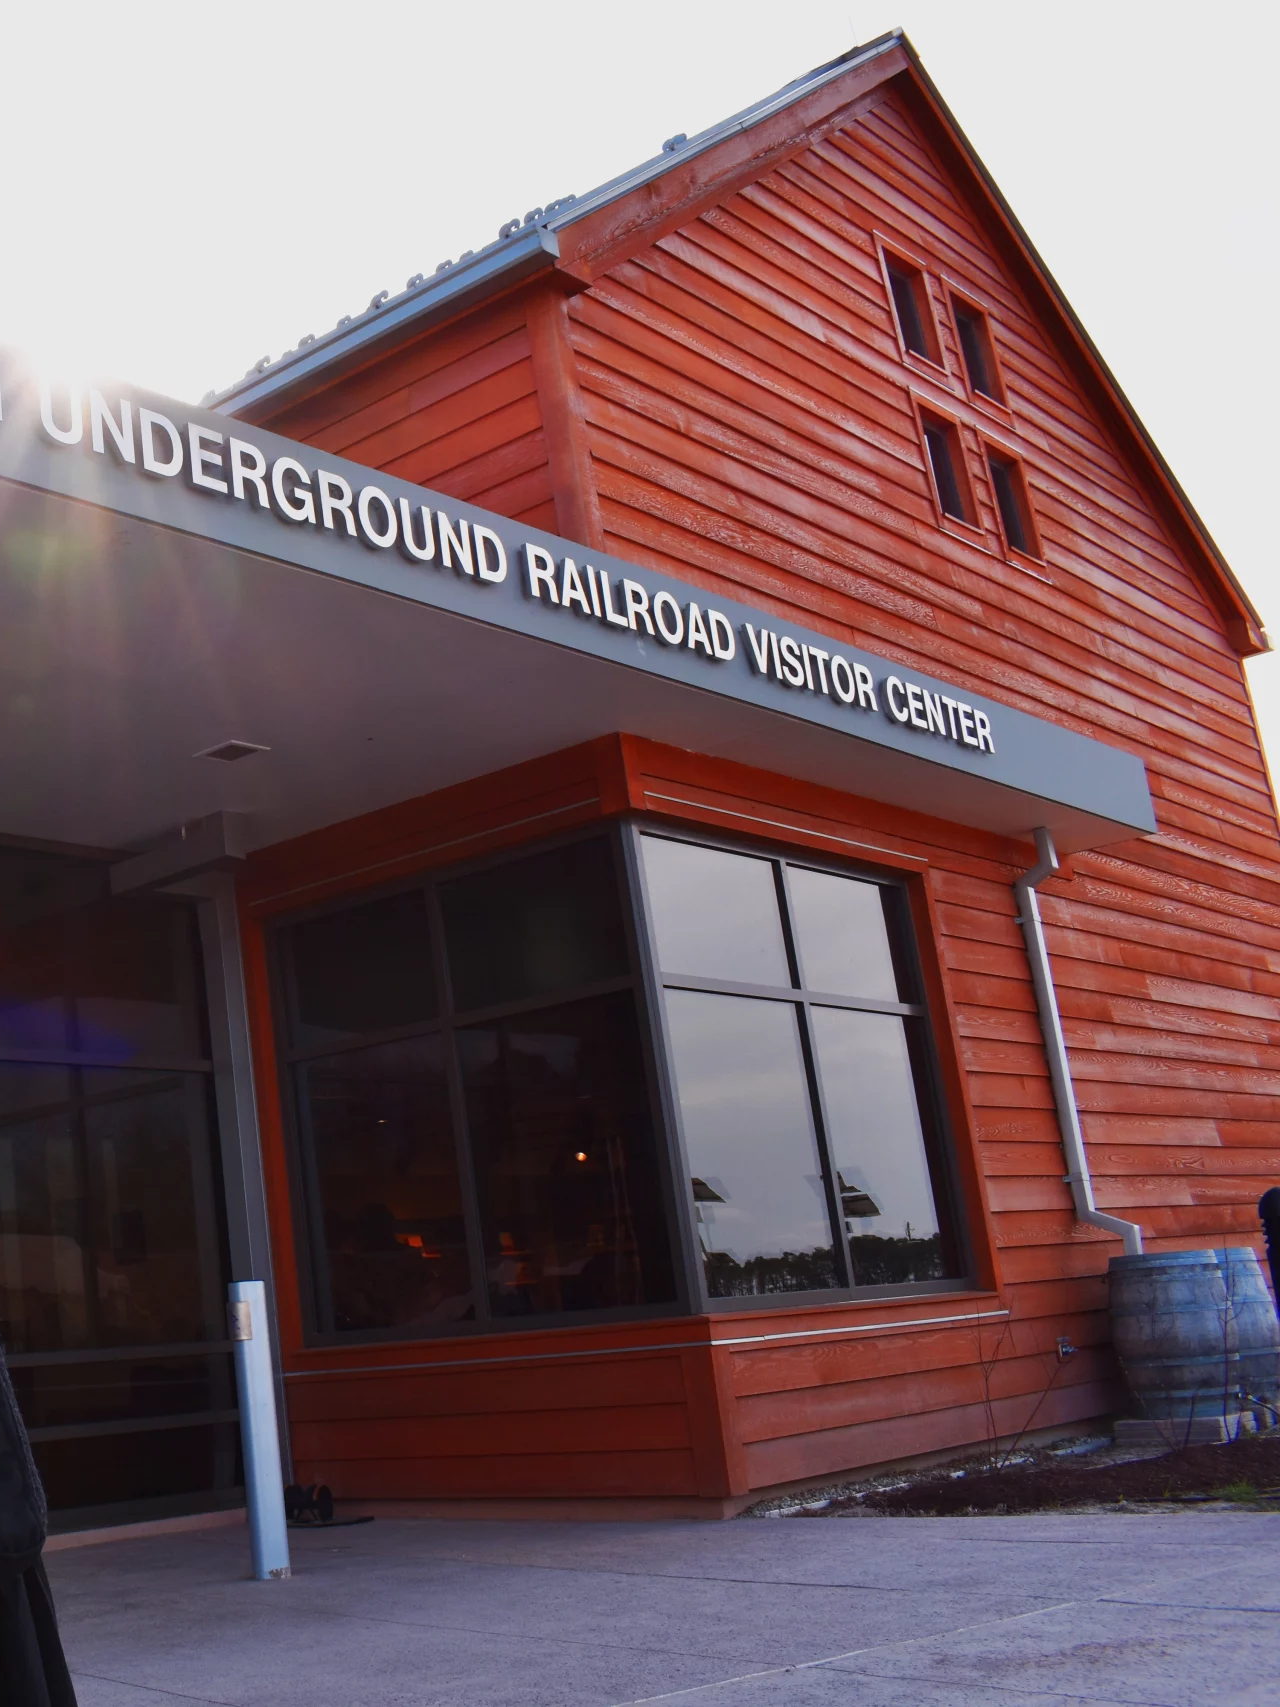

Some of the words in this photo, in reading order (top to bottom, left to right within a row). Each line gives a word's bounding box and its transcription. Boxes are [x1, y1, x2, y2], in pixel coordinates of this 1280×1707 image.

[39, 374, 508, 584] UNDERGROUND
[524, 542, 736, 661] RAILROAD
[744, 623, 878, 711] VISITOR
[886, 676, 995, 754] CENTER
